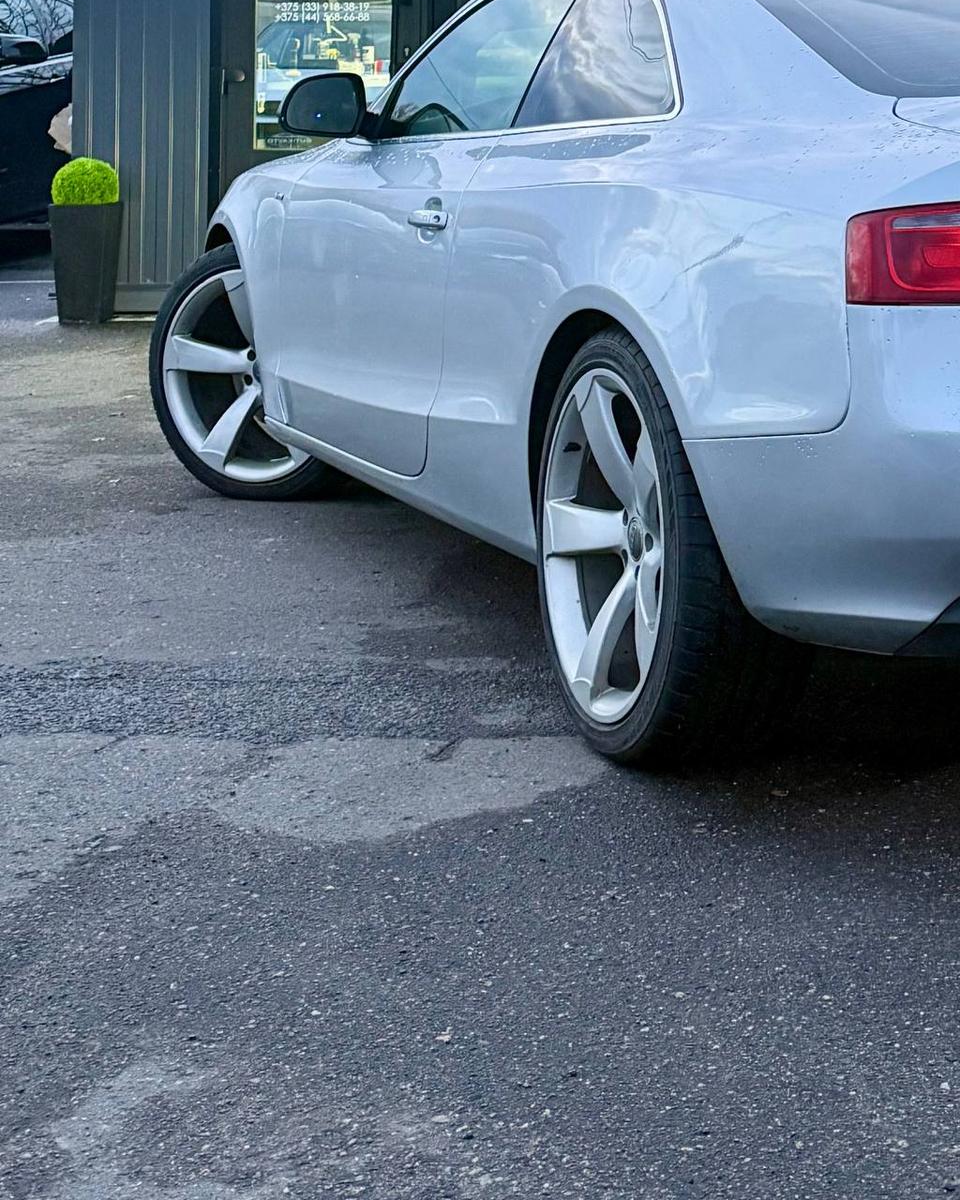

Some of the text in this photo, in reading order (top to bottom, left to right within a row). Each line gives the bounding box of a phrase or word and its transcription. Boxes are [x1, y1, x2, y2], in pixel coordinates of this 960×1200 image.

[275, 2, 370, 13] +375 (33) 918-38-19
[275, 13, 299, 22] +375
[301, 12, 320, 23] (44)
